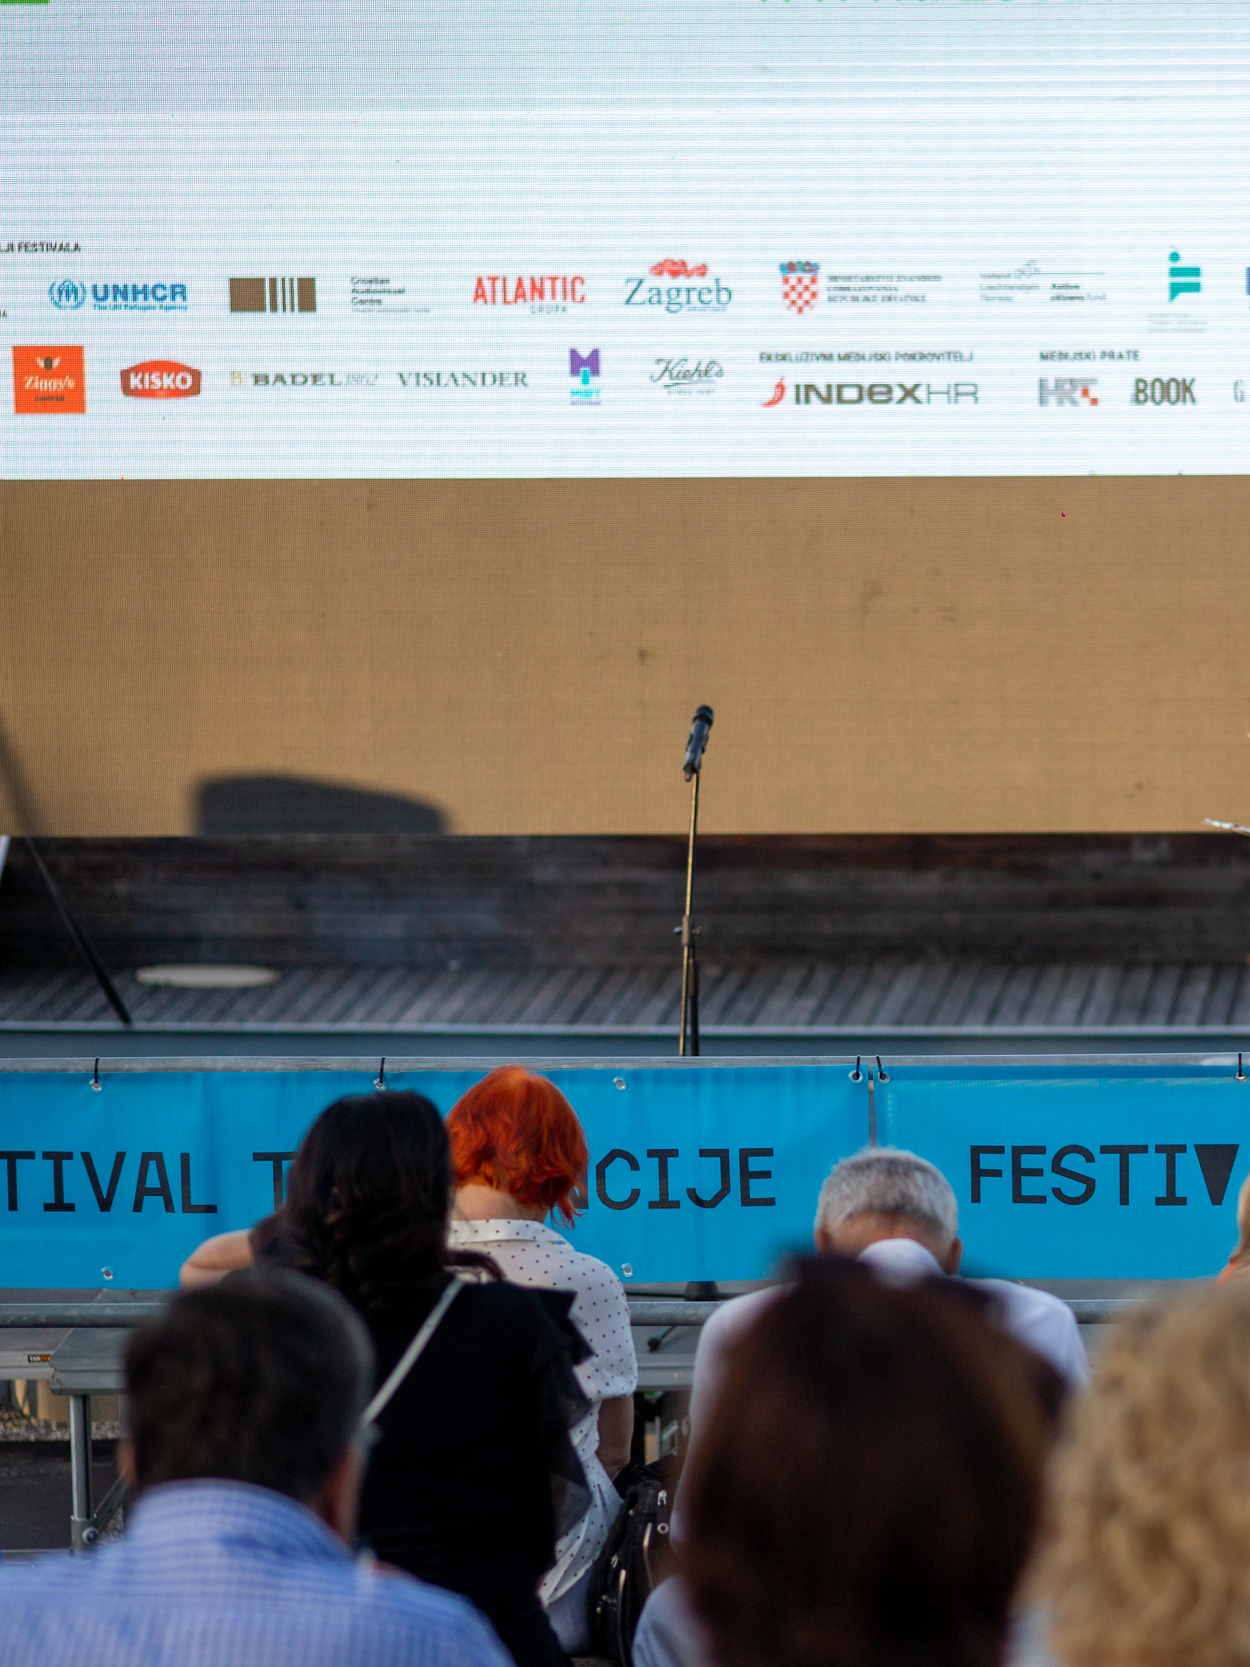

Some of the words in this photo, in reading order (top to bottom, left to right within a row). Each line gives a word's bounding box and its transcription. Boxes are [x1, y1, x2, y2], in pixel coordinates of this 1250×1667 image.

[18, 241, 81, 252] FESTIVALA
[92, 284, 187, 302] UNHCR
[473, 276, 585, 304] ATLANTIC
[624, 278, 732, 313] Zagreb
[1039, 350, 1096, 361] MEDIJSKI
[1100, 350, 1140, 361] PRATE
[130, 371, 193, 390] KISKO
[252, 372, 342, 386] BADEL
[398, 372, 529, 387] VISLANDER
[1133, 377, 1197, 406] BOOK
